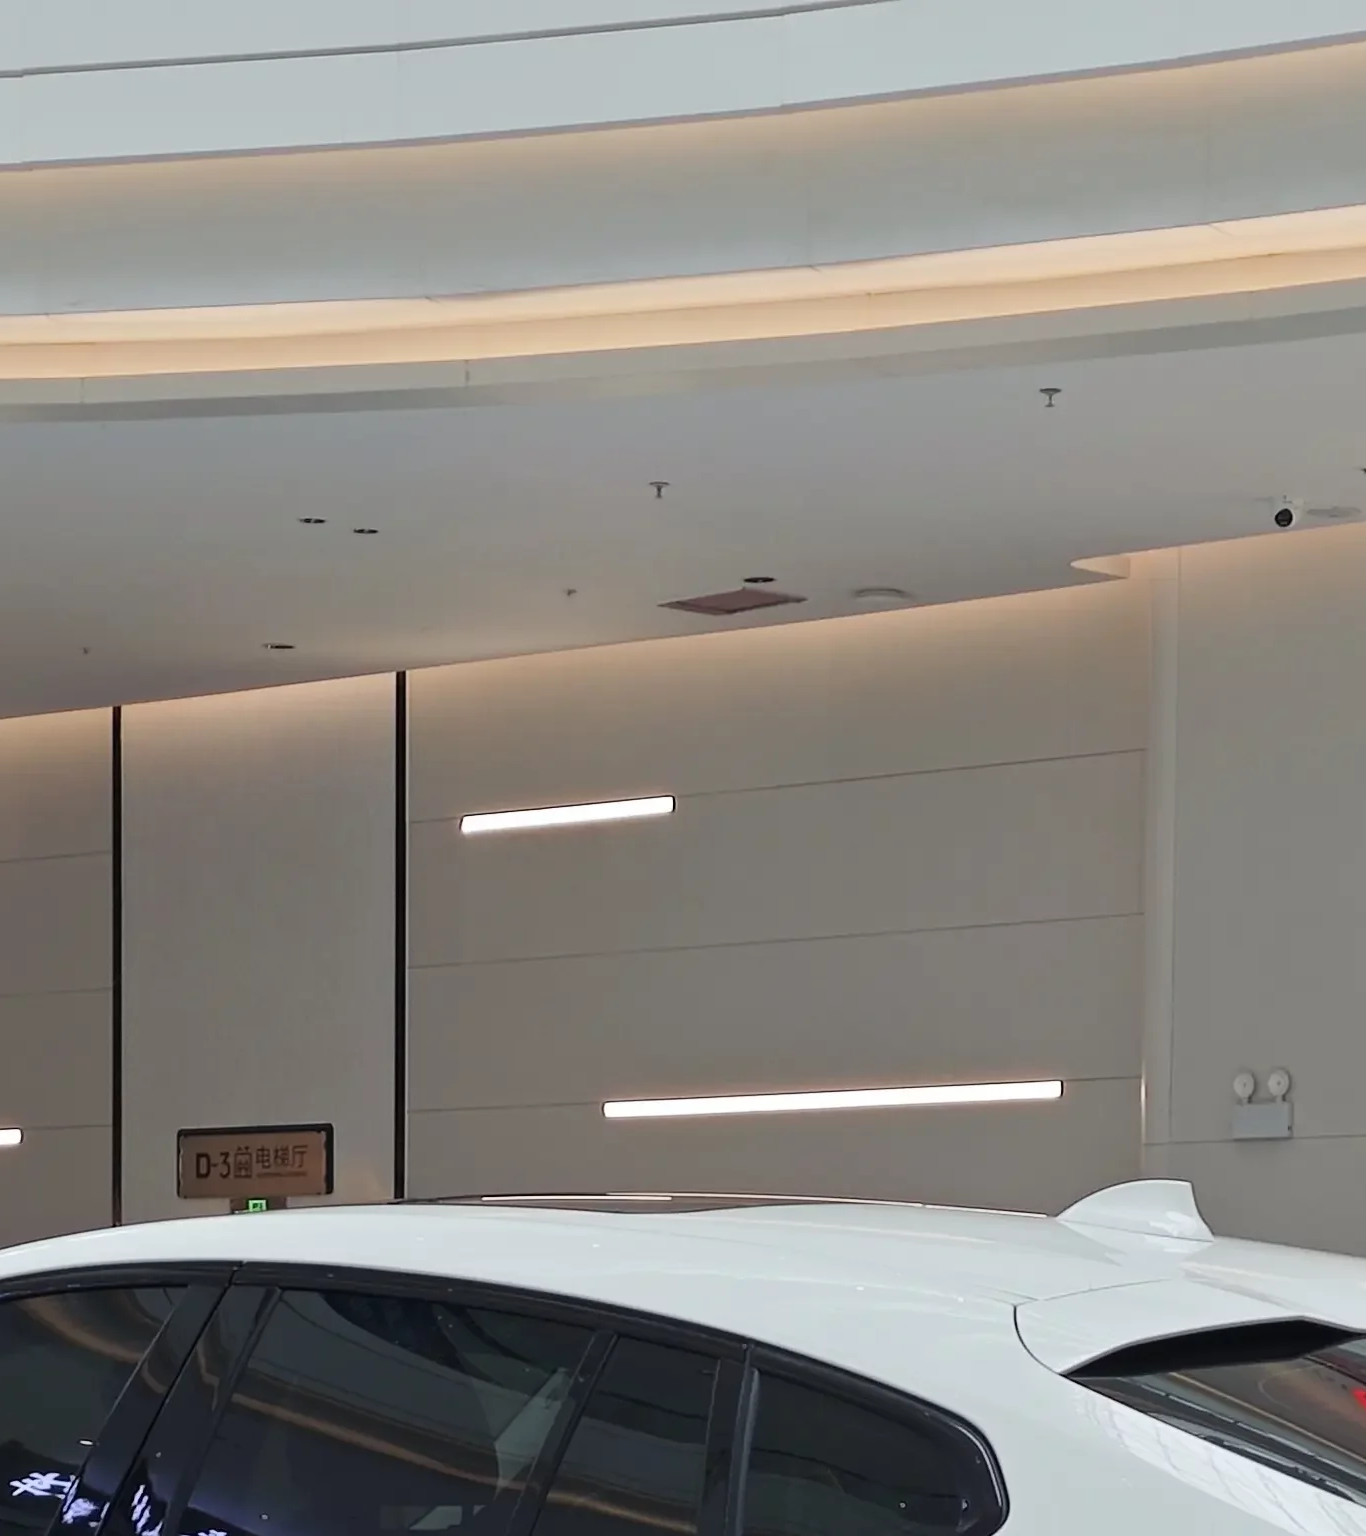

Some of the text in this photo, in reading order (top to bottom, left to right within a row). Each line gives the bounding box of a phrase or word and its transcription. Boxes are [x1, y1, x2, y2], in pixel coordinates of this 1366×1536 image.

[195, 1144, 309, 1179] D-3 电梯厅
